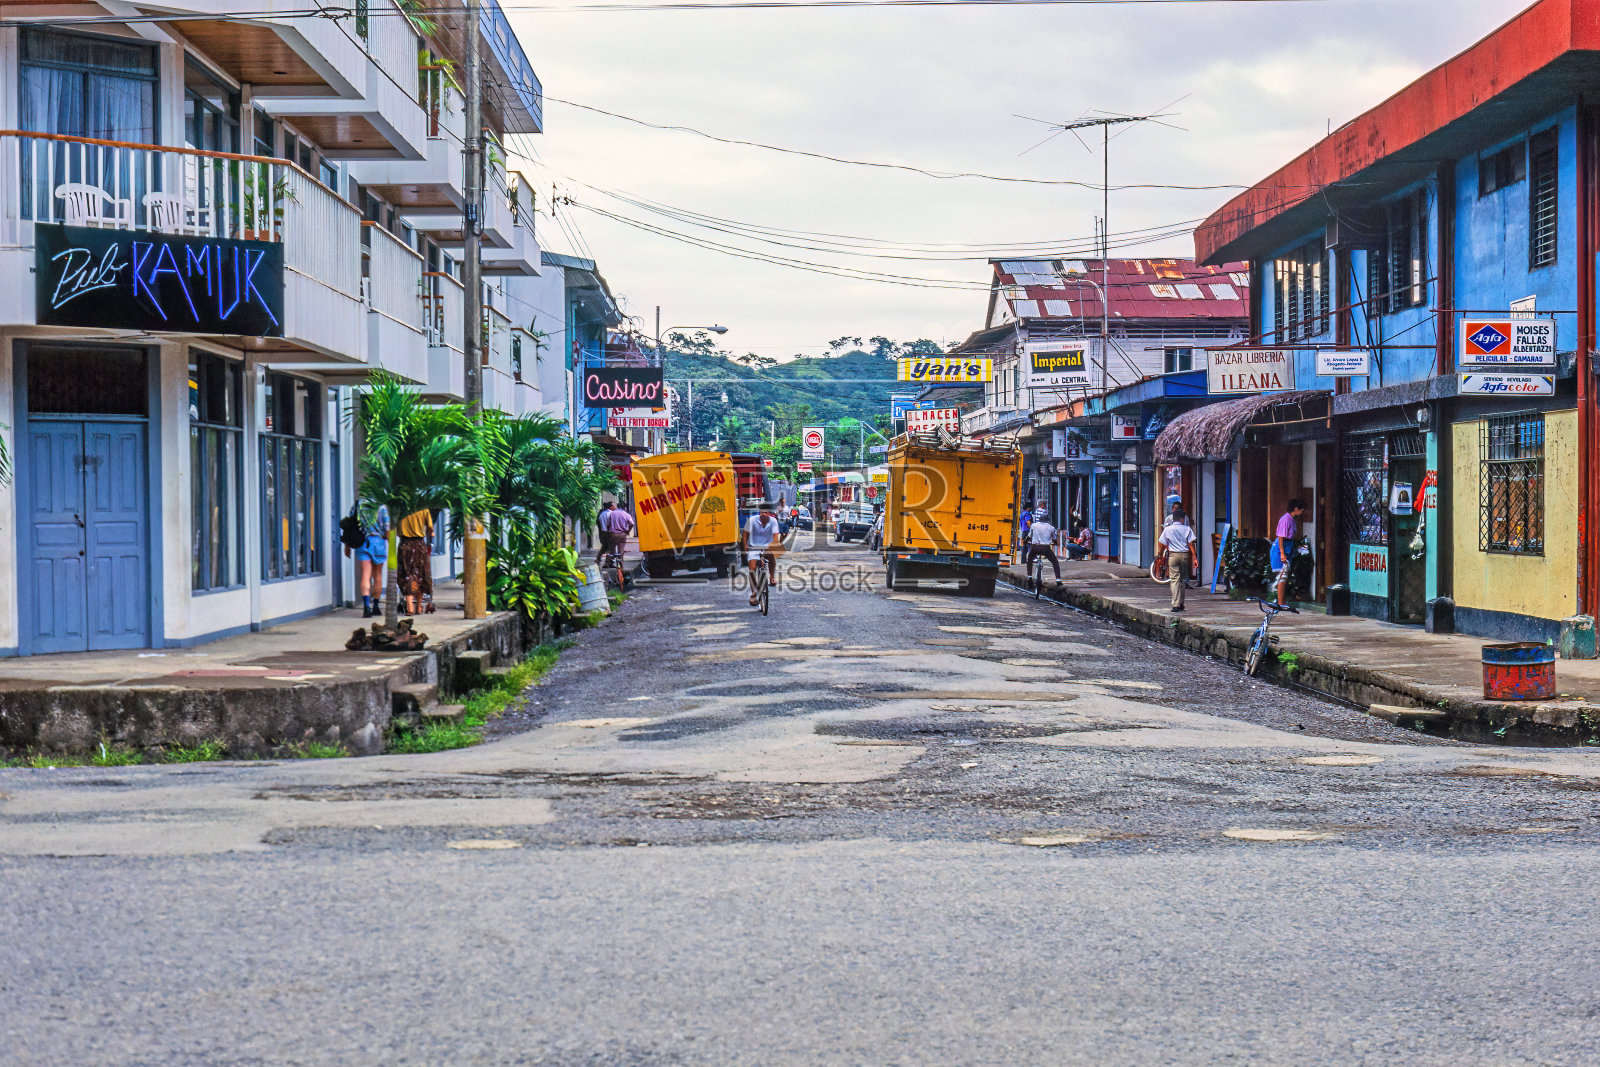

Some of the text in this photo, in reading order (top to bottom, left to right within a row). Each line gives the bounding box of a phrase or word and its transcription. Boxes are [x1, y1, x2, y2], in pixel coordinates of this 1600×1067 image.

[52, 241, 279, 326] Pub KAMUK
[1516, 325, 1550, 335] MOISES
[1473, 333, 1502, 344] Agfa
[1516, 335, 1548, 345] FALLAS
[1512, 345, 1552, 353] ALBERTAZZI
[1033, 351, 1083, 371] Imperial
[1214, 351, 1286, 365] BAZAR LIBRERIA
[1061, 376, 1089, 384] CENTRAL
[1221, 372, 1284, 391] ILEANA
[586, 374, 661, 400] Casino
[1478, 382, 1540, 393] Agfacolor
[907, 409, 958, 422] ALMACEN
[608, 418, 627, 427] POLLO
[628, 418, 646, 427] FRITO
[638, 471, 726, 516] MARAVILLOSO
[1354, 551, 1387, 573] LIBRERIA
